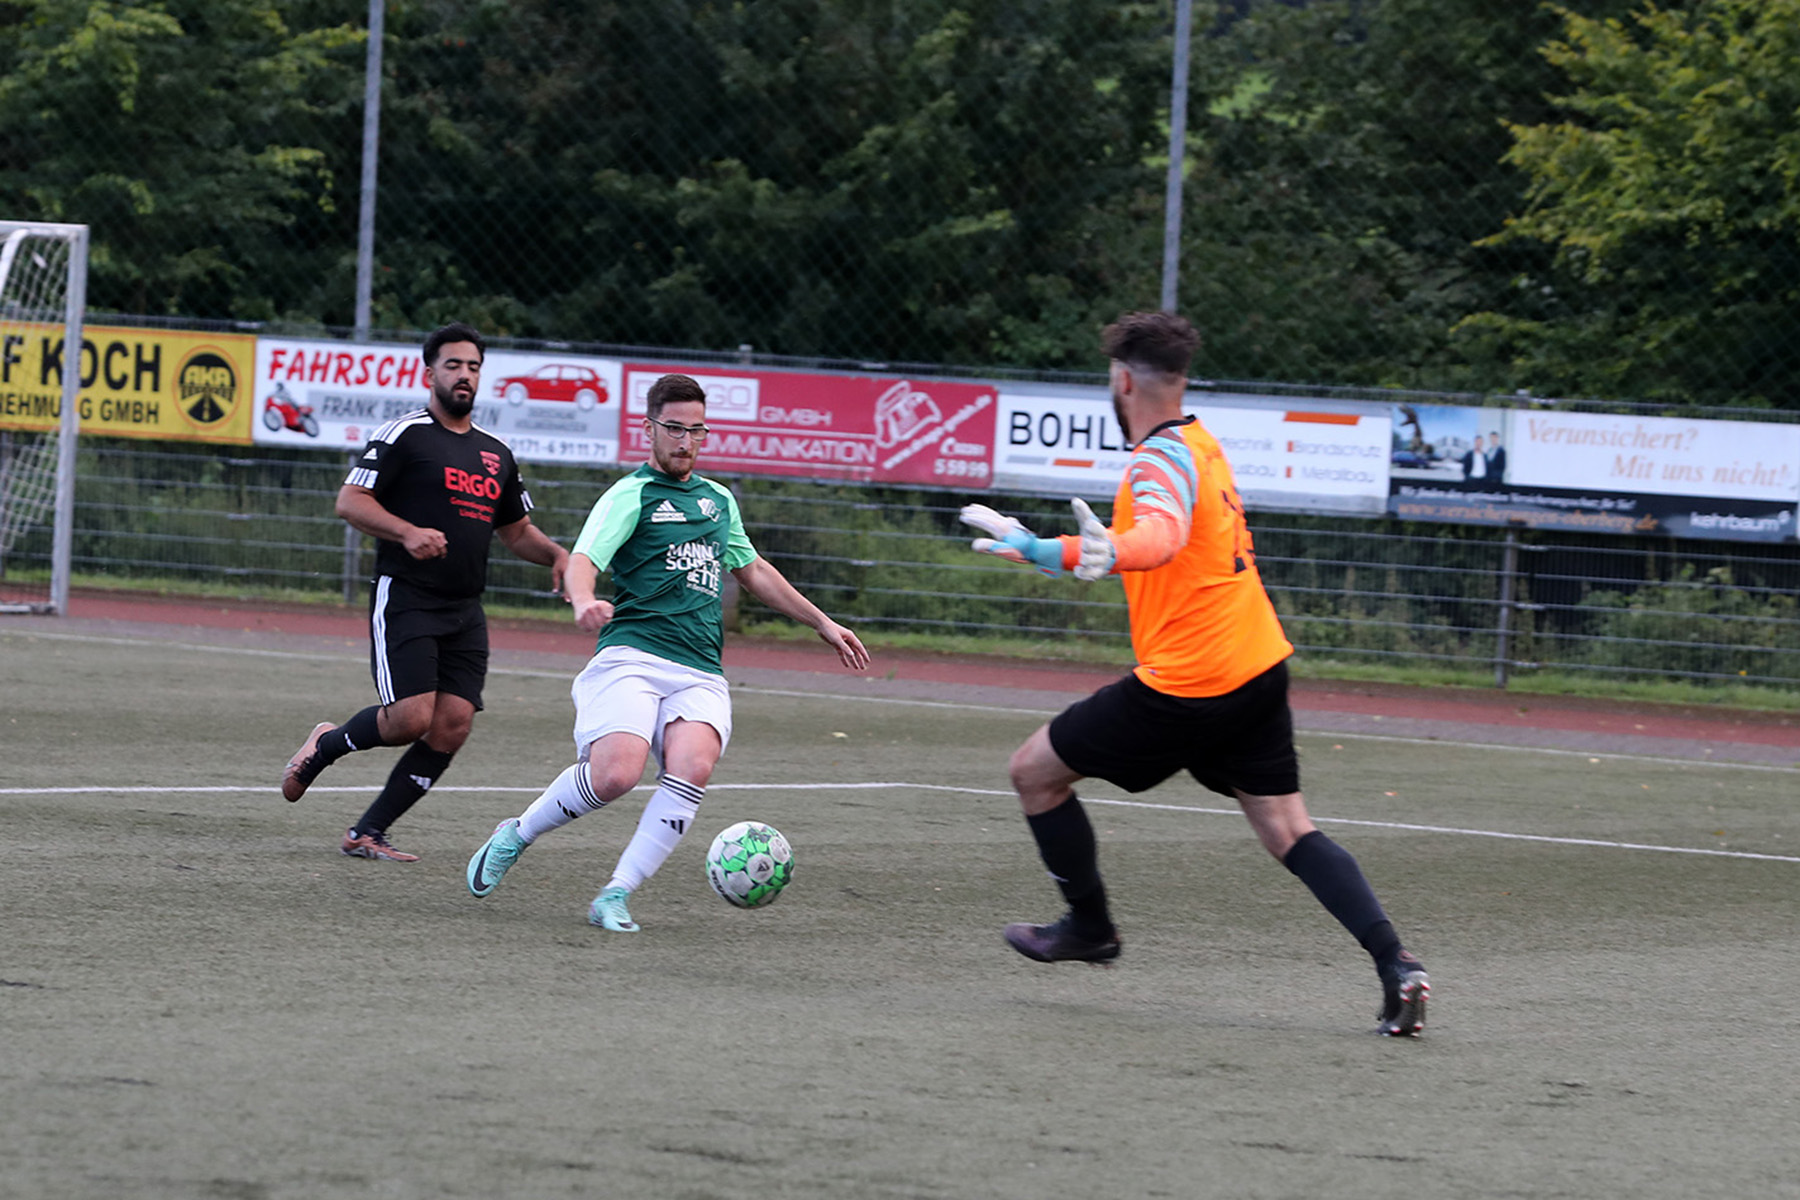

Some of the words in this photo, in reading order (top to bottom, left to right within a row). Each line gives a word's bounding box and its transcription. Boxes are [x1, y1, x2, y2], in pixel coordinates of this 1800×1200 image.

[41, 337, 161, 392] KOCH
[184, 365, 233, 387] AKA
[101, 399, 159, 424] GMBH
[321, 396, 376, 419] FRANK
[760, 406, 833, 427] GMBH
[1528, 418, 1698, 451] Verunsichert?
[1293, 440, 1382, 458] Brandschutz
[1610, 453, 1655, 480] Mit
[1661, 462, 1704, 482] uns
[1711, 461, 1789, 487] nicht!
[444, 466, 501, 500] ERGO
[1689, 511, 1781, 533] kehrbaum
